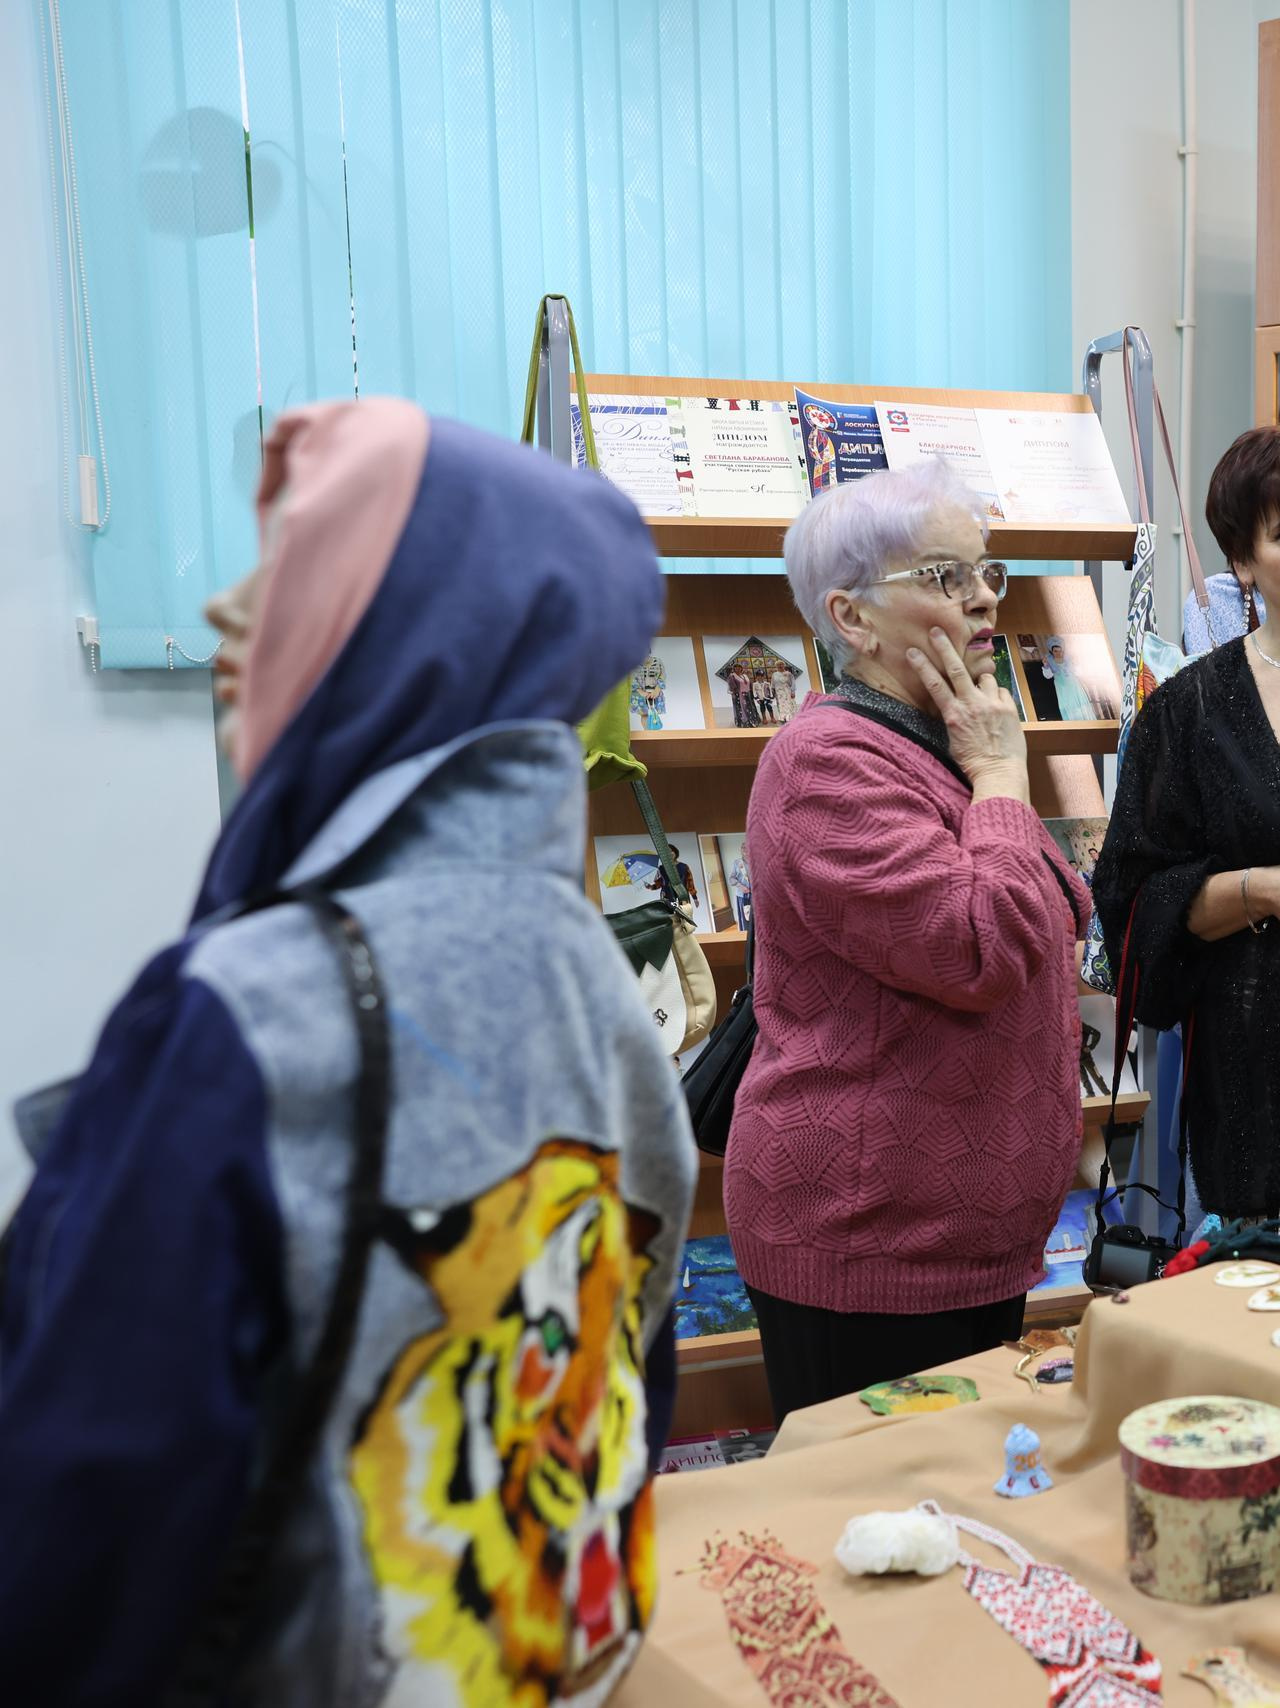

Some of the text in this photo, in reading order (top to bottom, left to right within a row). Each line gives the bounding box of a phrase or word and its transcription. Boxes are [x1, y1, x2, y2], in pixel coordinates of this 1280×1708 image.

[712, 433, 767, 442] ДИПЛОМ
[918, 441, 976, 452] БЛАГОДАРНОСТЬ
[1024, 440, 1072, 449] ДИПЛОМ
[704, 454, 742, 462] СВЕТЛАНА
